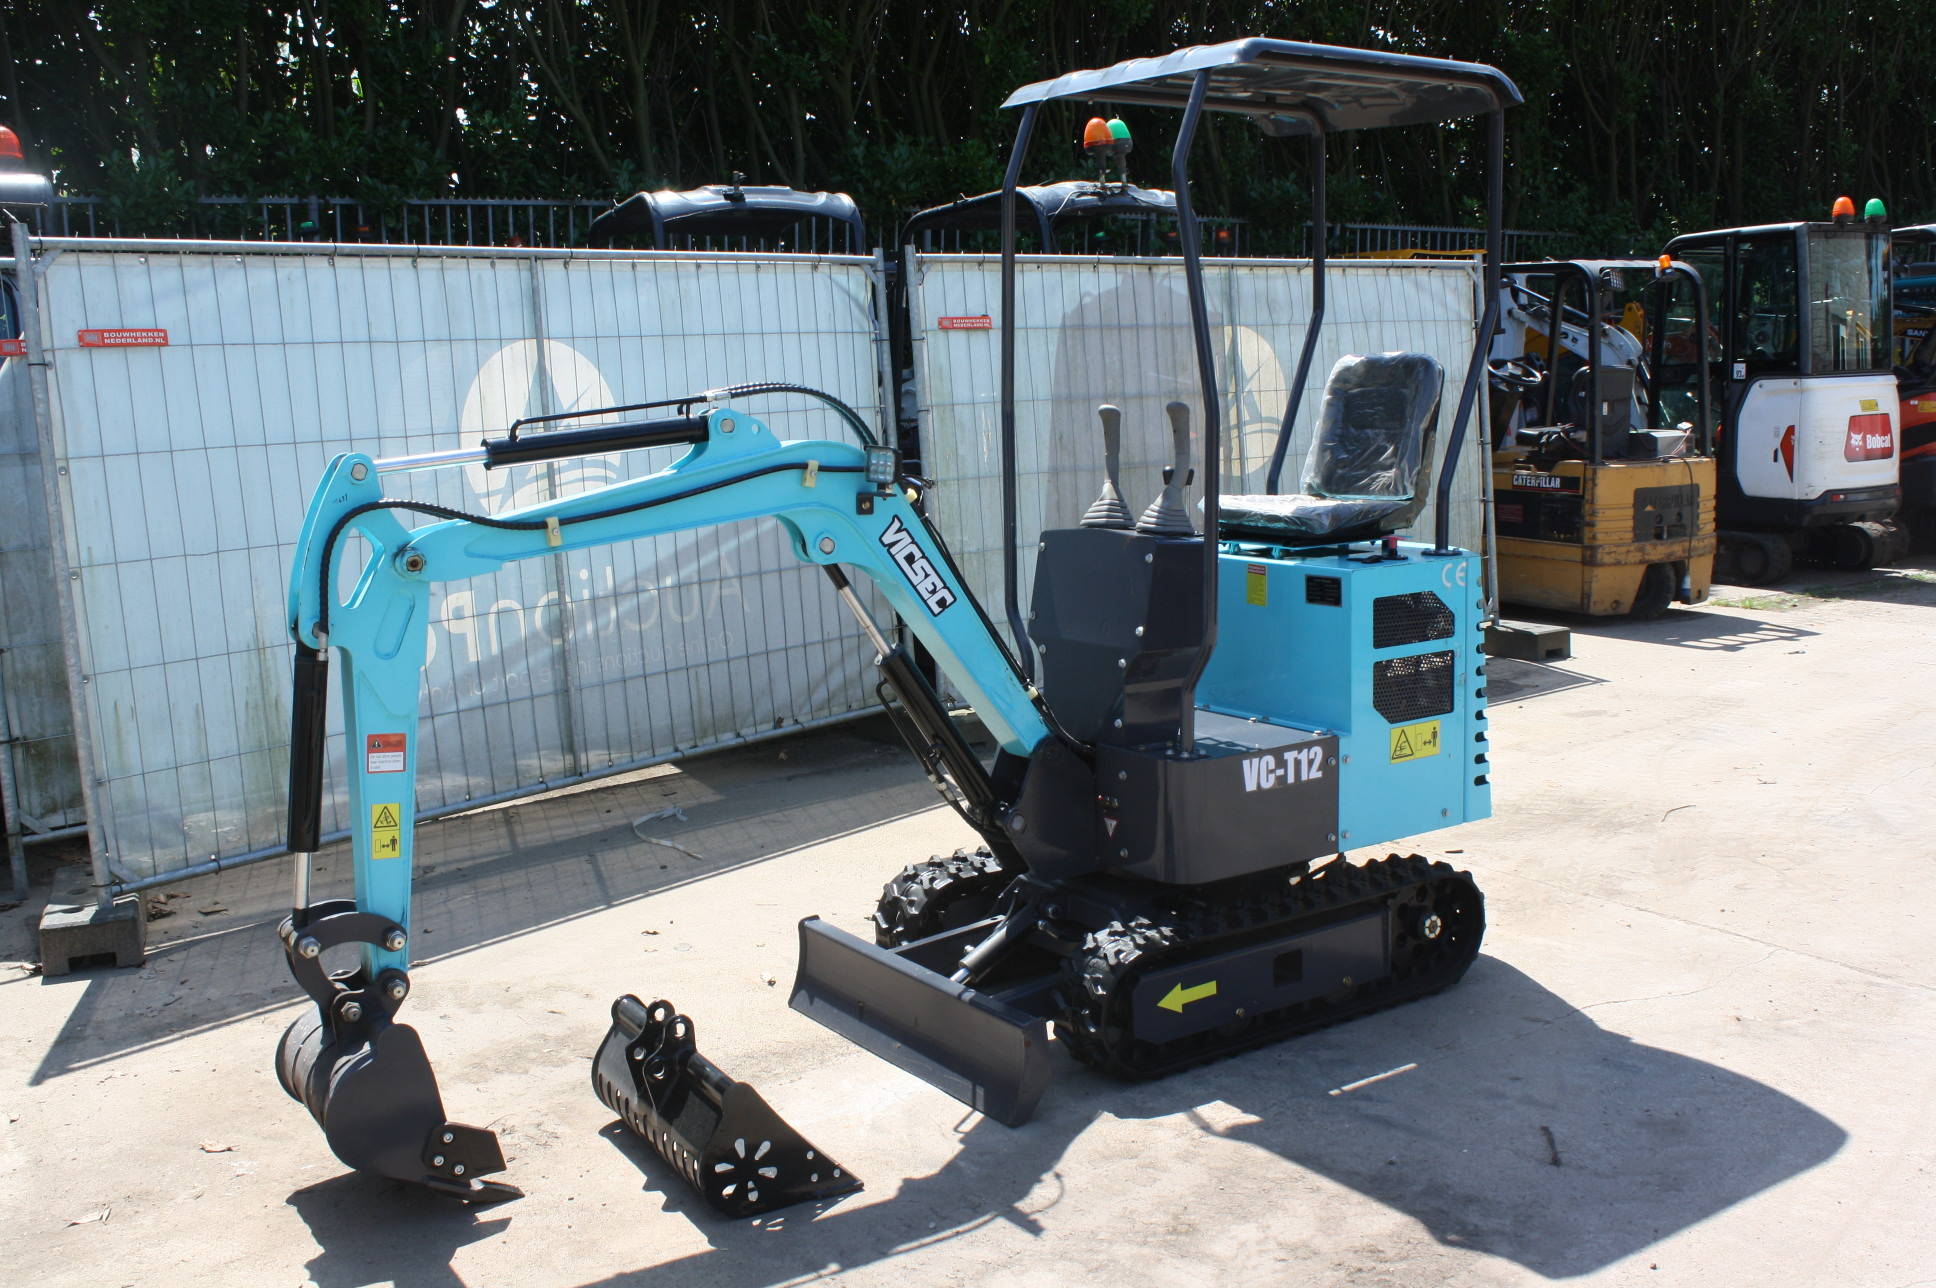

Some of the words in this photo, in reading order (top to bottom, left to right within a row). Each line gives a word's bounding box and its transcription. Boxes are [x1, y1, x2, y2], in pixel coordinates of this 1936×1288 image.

[1866, 433, 1891, 449] Bobcat
[880, 515, 956, 616] VICSEC
[1242, 745, 1323, 792] VC-T12
